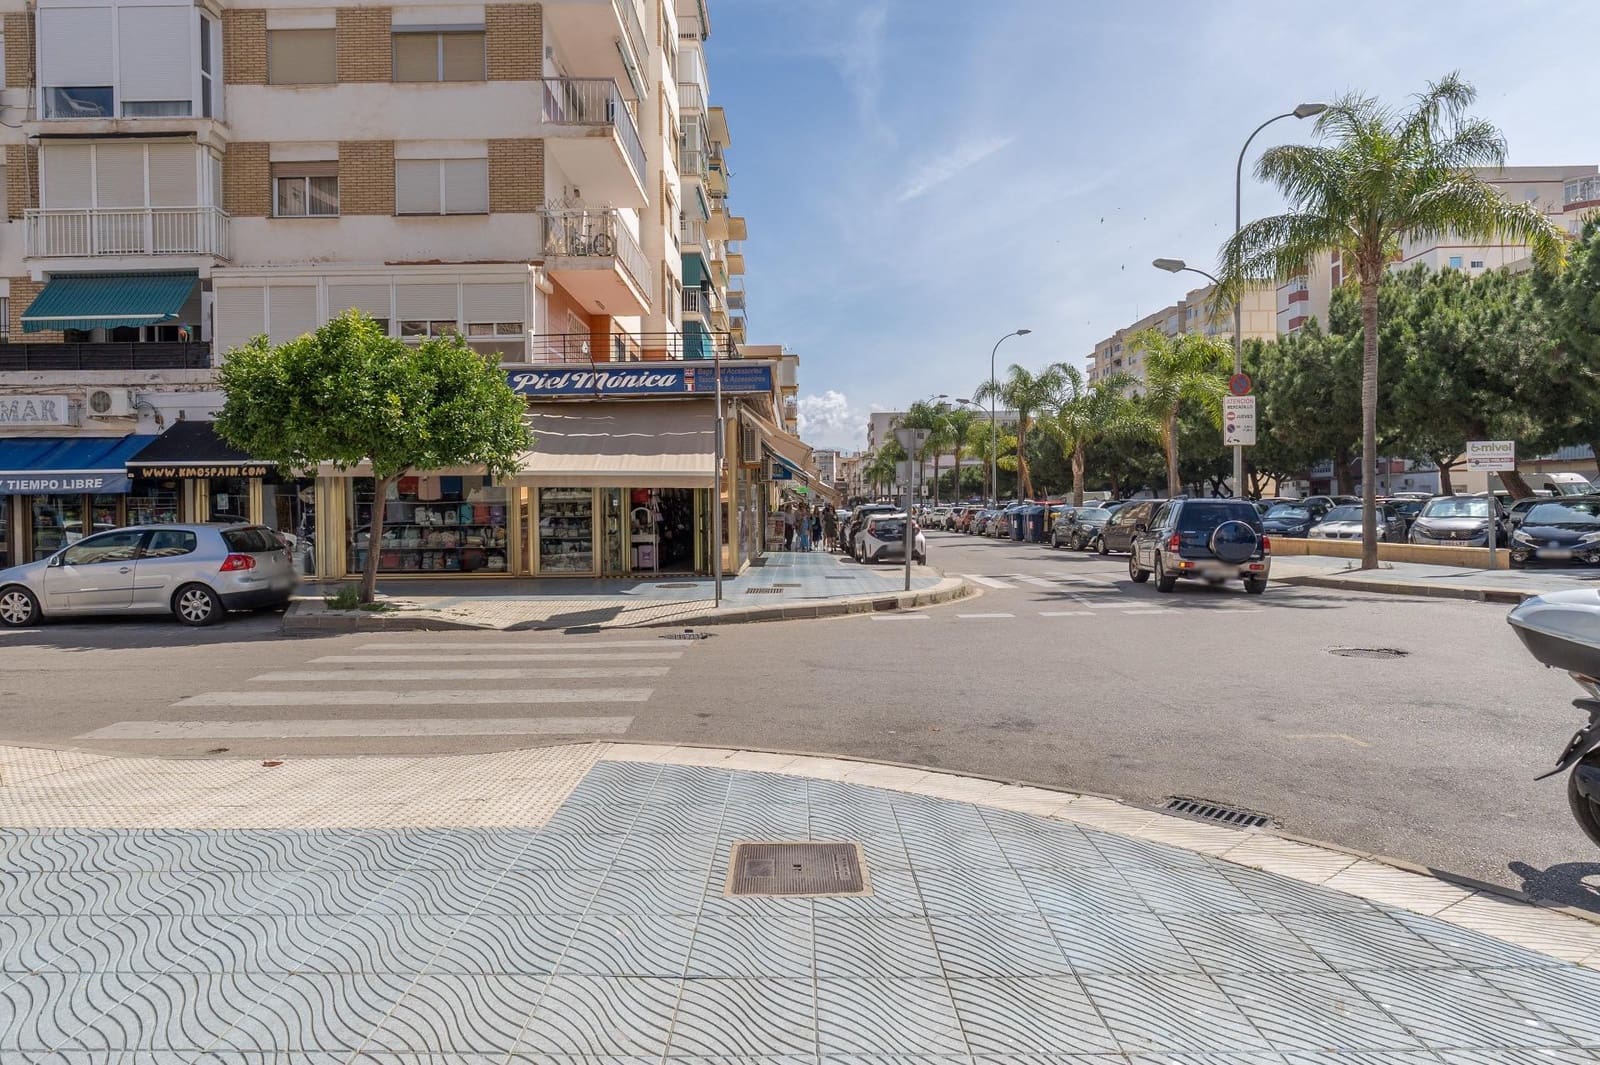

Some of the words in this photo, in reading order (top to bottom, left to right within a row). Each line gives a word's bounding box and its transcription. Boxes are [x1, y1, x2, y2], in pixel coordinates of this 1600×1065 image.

[513, 372, 570, 391] Piel
[571, 371, 678, 391] Mónica
[7, 479, 59, 490] TIEMPO
[62, 478, 103, 489] LIBRE
